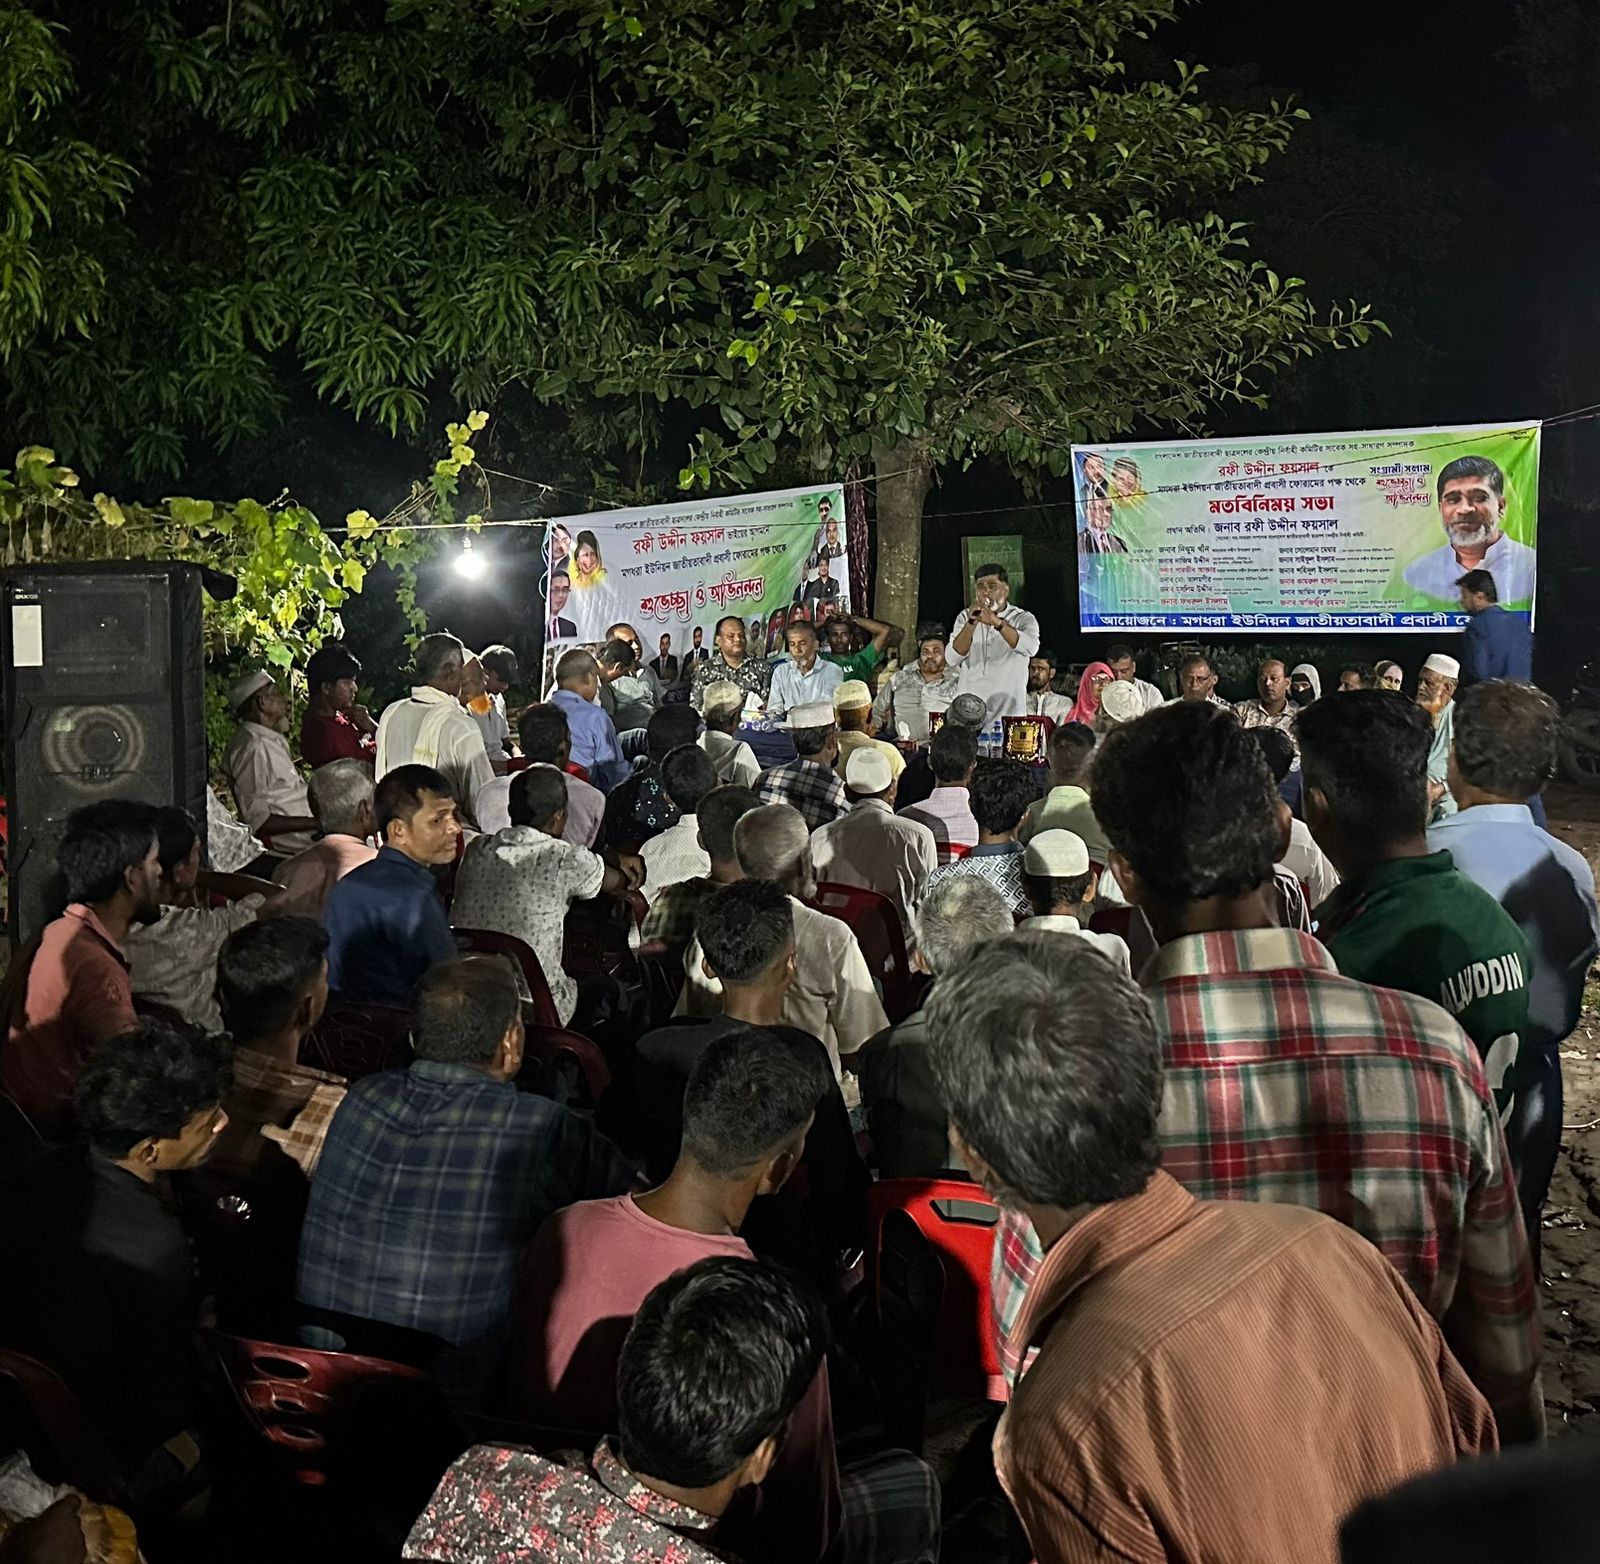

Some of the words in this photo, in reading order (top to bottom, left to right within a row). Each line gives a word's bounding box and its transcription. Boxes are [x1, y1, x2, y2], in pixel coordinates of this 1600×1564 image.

[1218, 461, 1239, 477] রফী
[1243, 460, 1275, 476] উদ্দীন
[1208, 494, 1295, 513] মতবিনিময়
[1301, 495, 1335, 512] সভা
[1213, 521, 1241, 534] জনাব
[1244, 519, 1264, 532] রফী
[1268, 517, 1297, 531] উদ্দীন
[1301, 519, 1339, 531] ফয়সাল
[632, 532, 654, 555] রফী
[658, 528, 687, 550] উদ্দীন
[690, 527, 725, 546] ফয়সাল
[1100, 614, 1167, 627] আয়োজনে
[1182, 615, 1227, 627] মগধরা
[1231, 613, 1291, 627] ইউনিয়ন
[1295, 613, 1396, 627] জাতীয়তাবাদী
[1401, 612, 1450, 626] প্রবাসী
